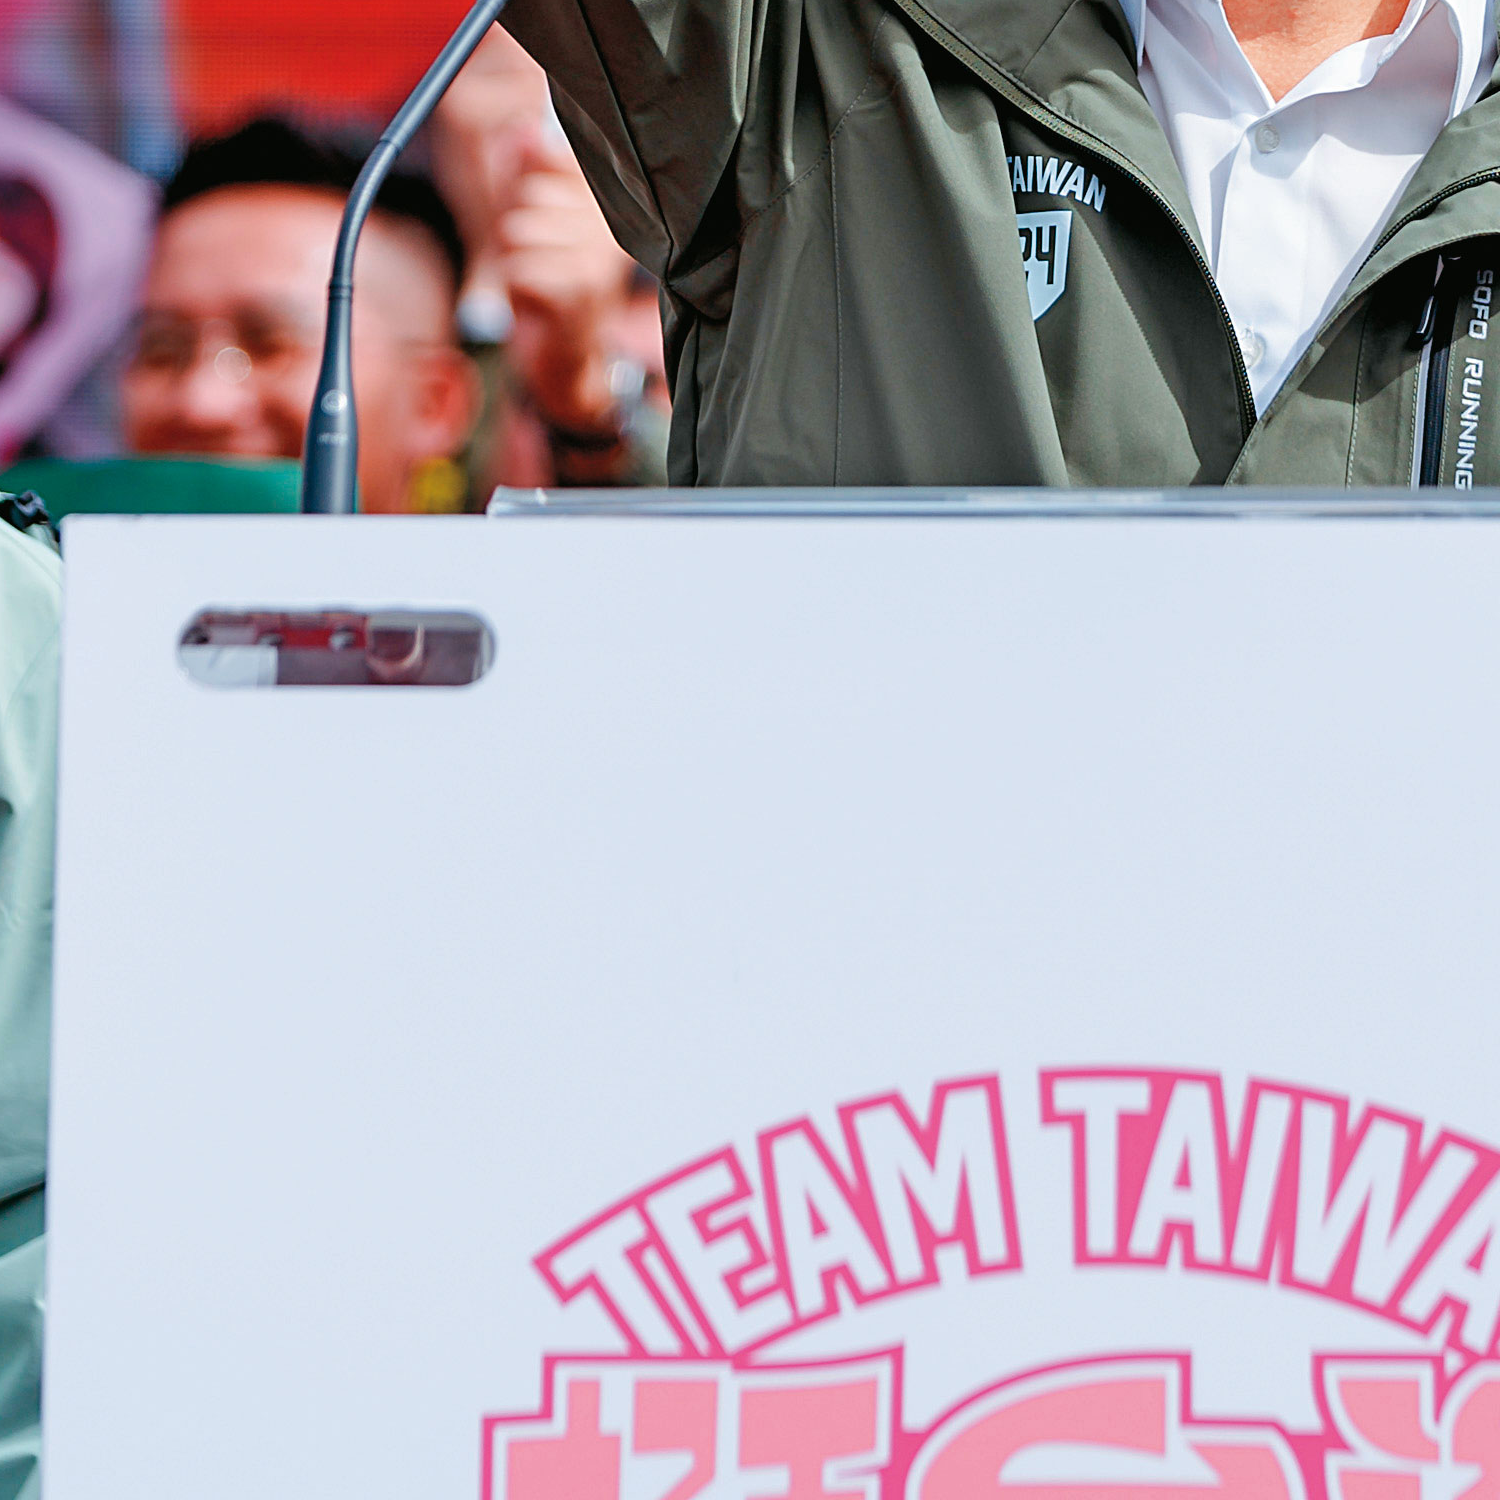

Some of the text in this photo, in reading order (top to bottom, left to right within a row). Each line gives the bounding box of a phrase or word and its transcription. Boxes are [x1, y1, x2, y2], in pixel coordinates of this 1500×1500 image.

[1007, 155, 1107, 213] AIWAN
[1454, 269, 1494, 492] SOFO RUNNING
[532, 1070, 1024, 1364] TEAM
